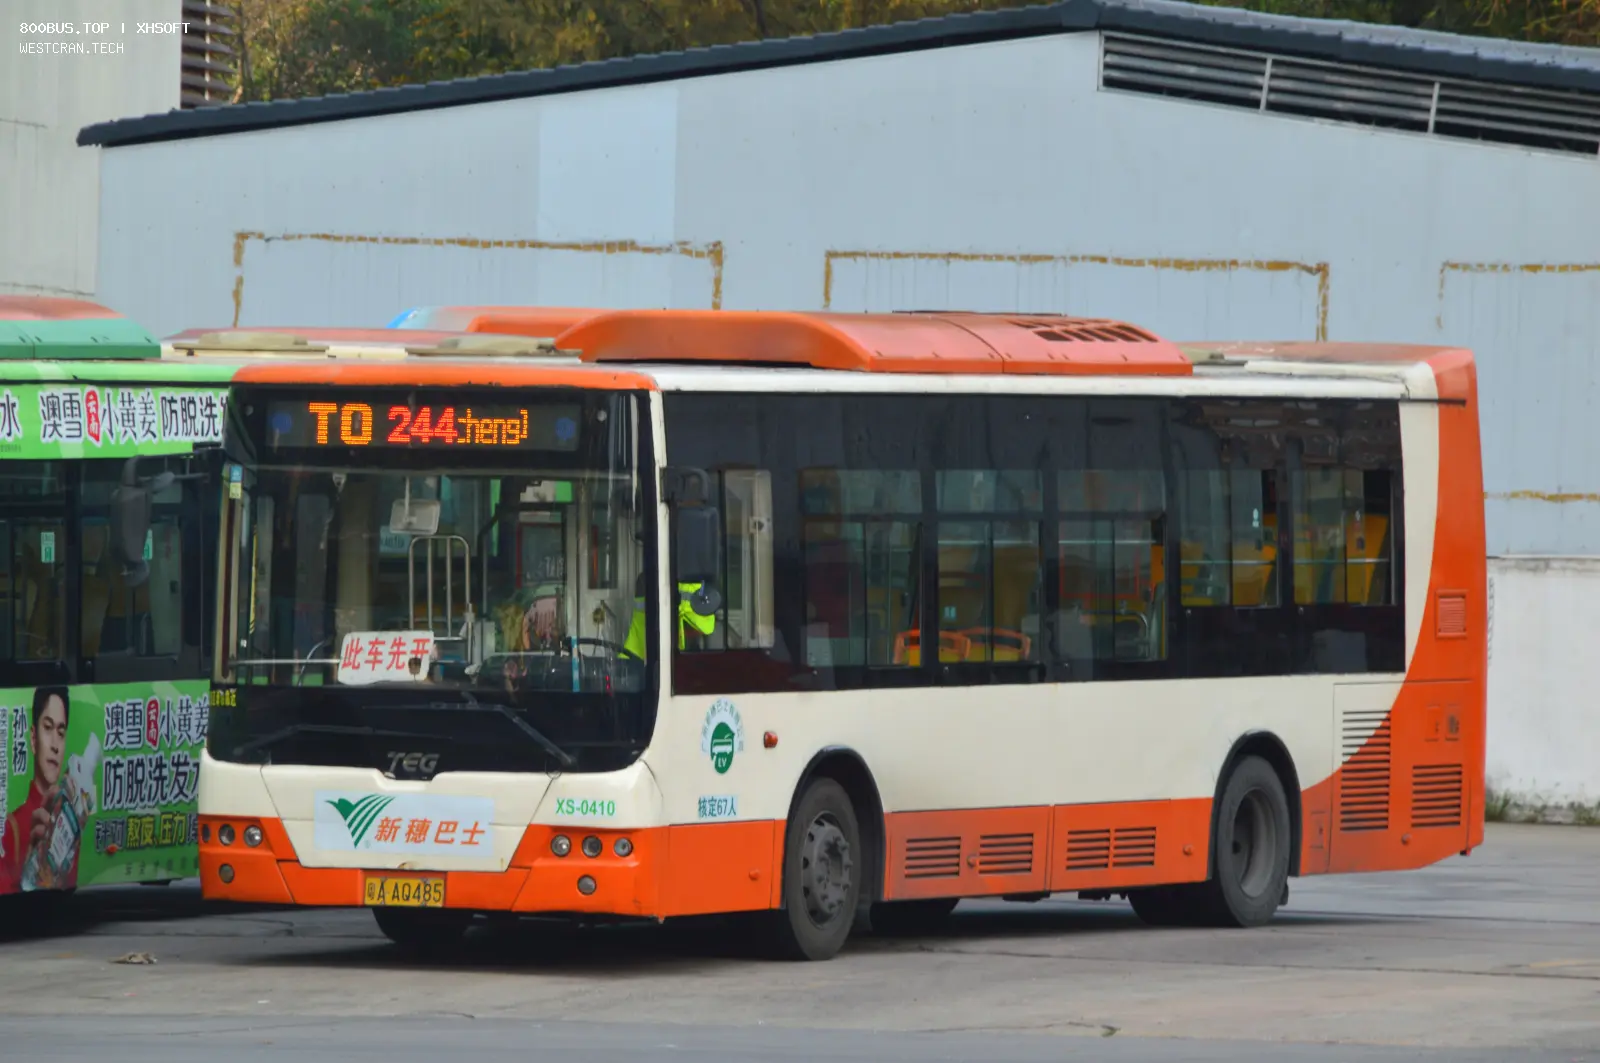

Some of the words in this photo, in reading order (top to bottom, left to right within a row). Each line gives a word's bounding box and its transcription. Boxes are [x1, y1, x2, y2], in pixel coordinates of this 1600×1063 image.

[161, 395, 229, 437] 防脱洗
[309, 402, 373, 445] TO
[387, 406, 457, 443] 244
[341, 636, 431, 671] 此车先开
[13, 705, 27, 773] 孙杨
[387, 752, 440, 772] TEG
[556, 798, 615, 816] XS-0410
[698, 796, 737, 817] 核定67人
[374, 816, 485, 845] 新穗巴士
